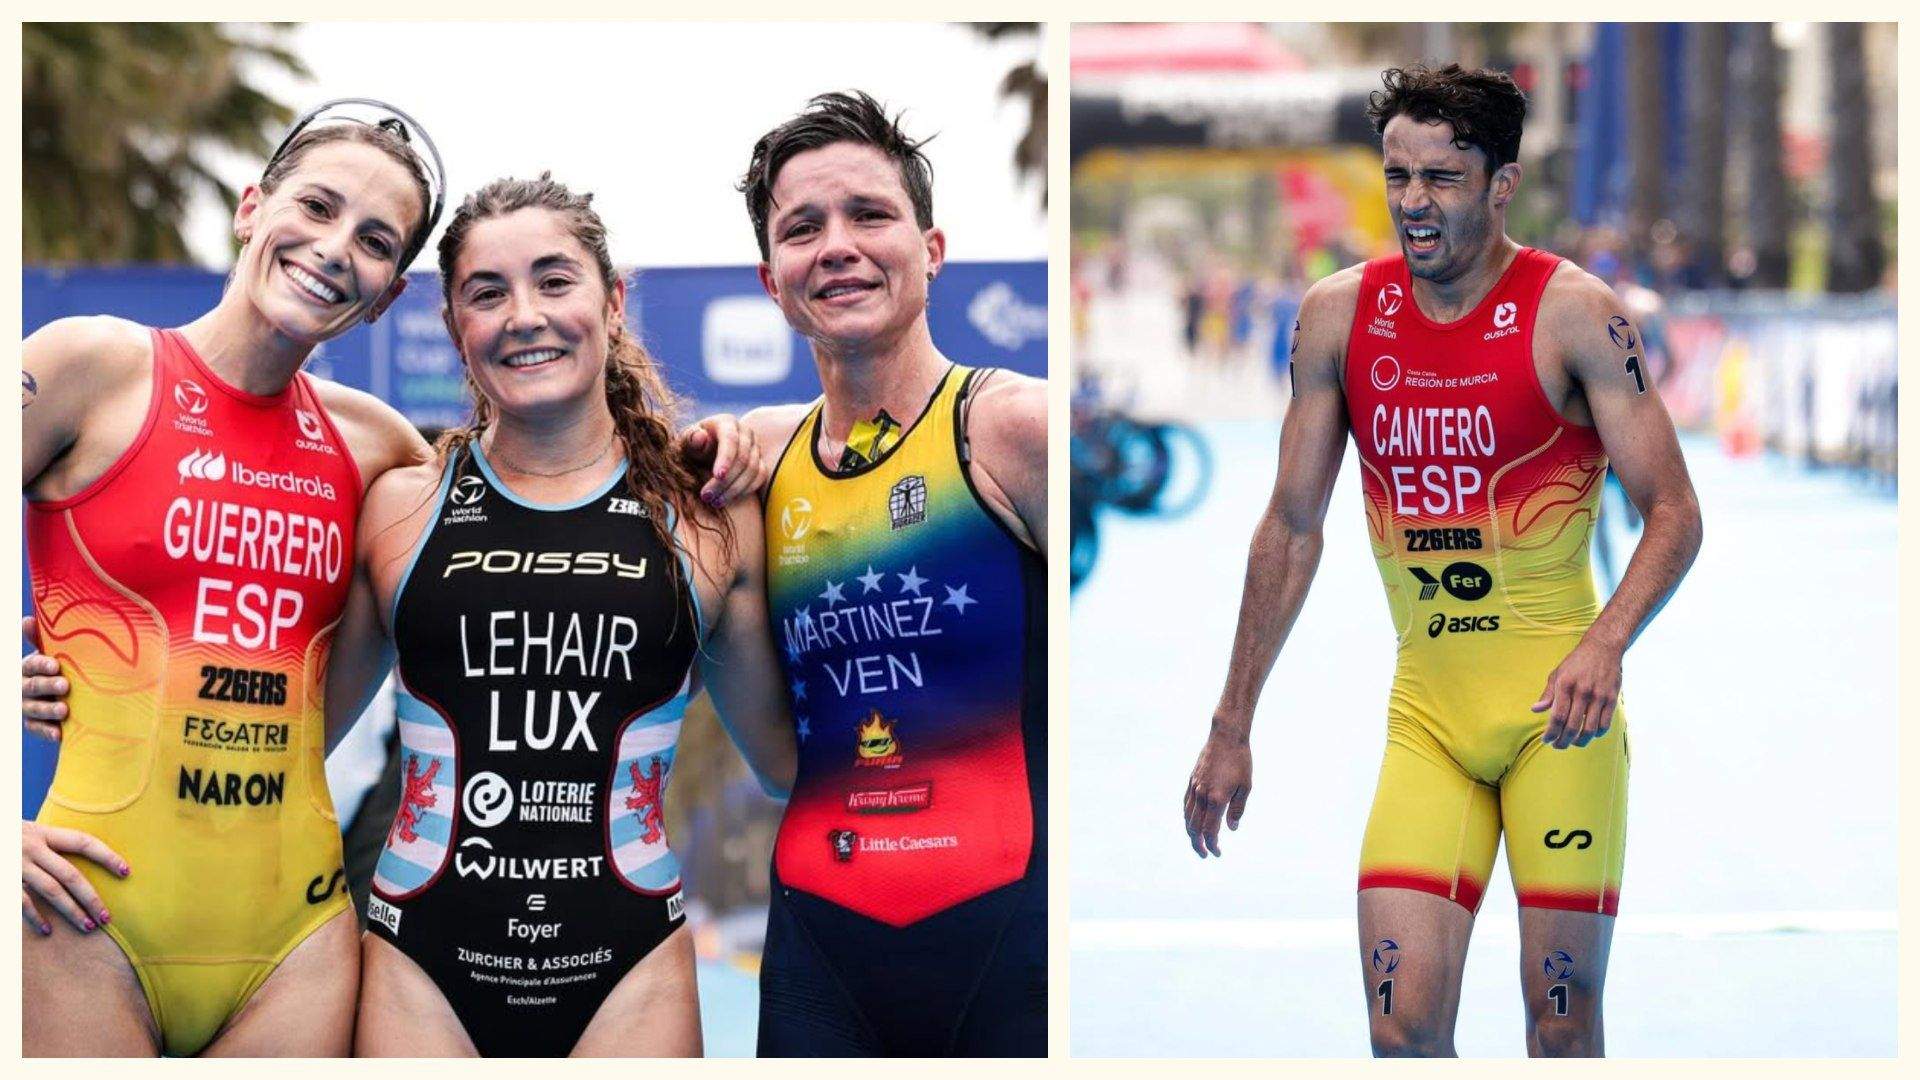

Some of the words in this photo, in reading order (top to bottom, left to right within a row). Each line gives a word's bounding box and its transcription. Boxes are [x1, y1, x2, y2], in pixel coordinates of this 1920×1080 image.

[1367, 324, 1397, 340] Triathlon
[1374, 316, 1395, 329] World
[1483, 325, 1520, 341] austral
[1445, 378, 1458, 388] DE
[1459, 371, 1499, 387] MURCIA
[1625, 354, 1646, 396] 1
[1372, 403, 1496, 457] CANTERO
[231, 462, 336, 501] Iberdrola
[1391, 465, 1482, 516] ESP
[163, 496, 343, 585] GUERRERO
[1404, 528, 1483, 552] 226ERS
[442, 550, 648, 579] POISSY
[1450, 574, 1483, 589] Fer
[193, 576, 305, 651] ESP
[784, 597, 942, 654] MARTINEZ
[1447, 615, 1500, 634] asics
[459, 611, 639, 680] LEHAIR
[198, 665, 289, 706] 226ERS
[824, 652, 924, 697] VEN
[488, 690, 601, 752] LUX
[178, 765, 284, 806] NARON
[520, 781, 596, 804] LOTERIE
[519, 805, 593, 823] NATIONALE
[860, 836, 900, 852] Little
[900, 835, 959, 851] Caesars
[455, 851, 603, 880] WILWERT
[507, 918, 562, 944] Foyer
[458, 947, 523, 970] ZURCHER
[527, 958, 538, 971] &
[541, 947, 613, 970] ASSOCIÉS
[470, 970, 499, 984] Agence
[500, 975, 542, 987] Principale
[1377, 978, 1394, 1016] 1
[1547, 983, 1569, 1016] 1
